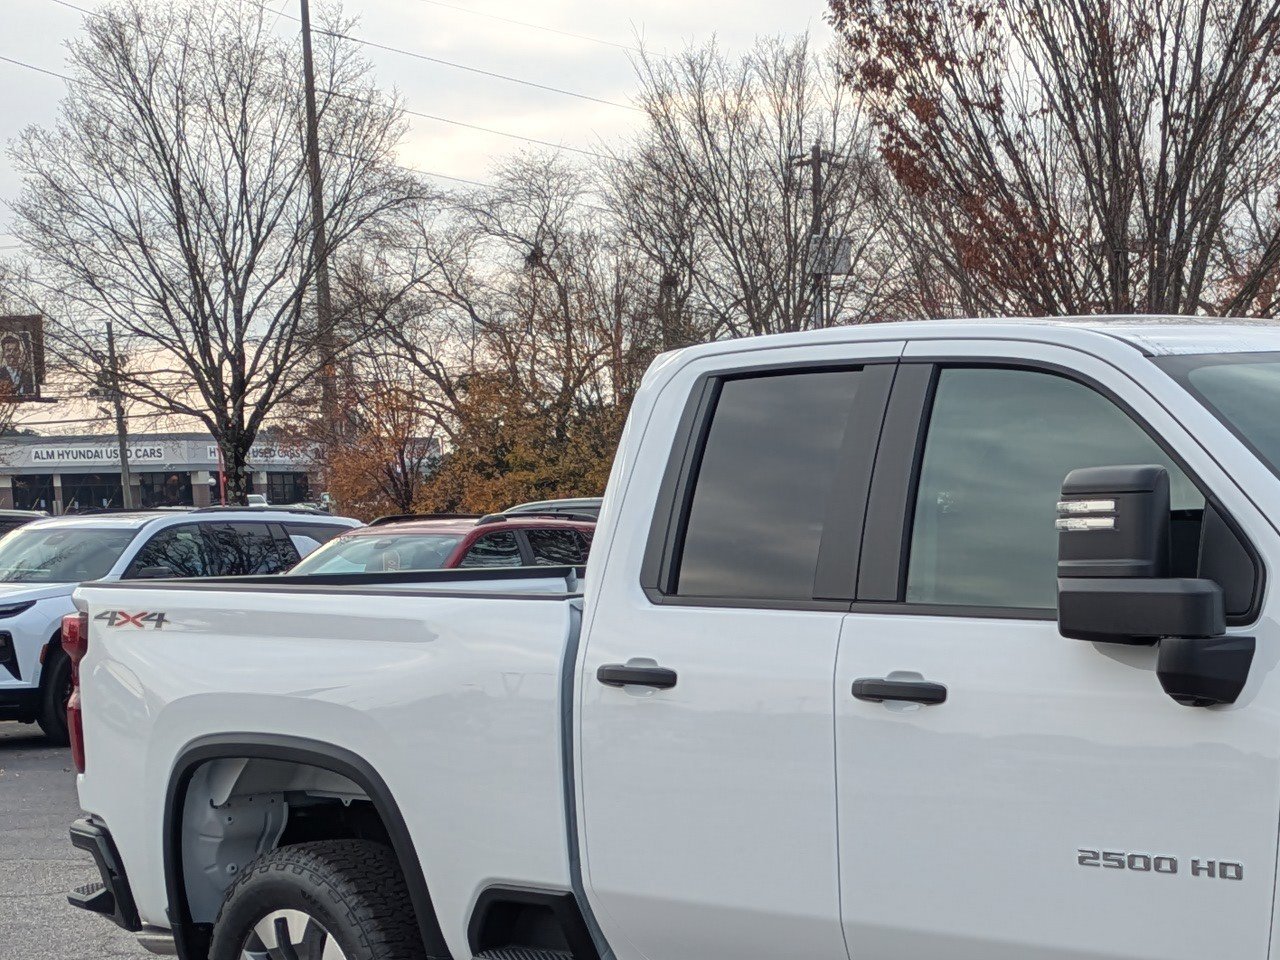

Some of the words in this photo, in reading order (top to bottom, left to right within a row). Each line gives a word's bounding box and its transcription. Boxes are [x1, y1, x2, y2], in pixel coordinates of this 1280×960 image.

[34, 450, 55, 460] ALM
[57, 449, 103, 460] HYUNDAI
[105, 448, 132, 459] USD
[135, 448, 163, 459] CARS
[1077, 849, 1178, 873] 2500
[1191, 858, 1244, 880] HD
